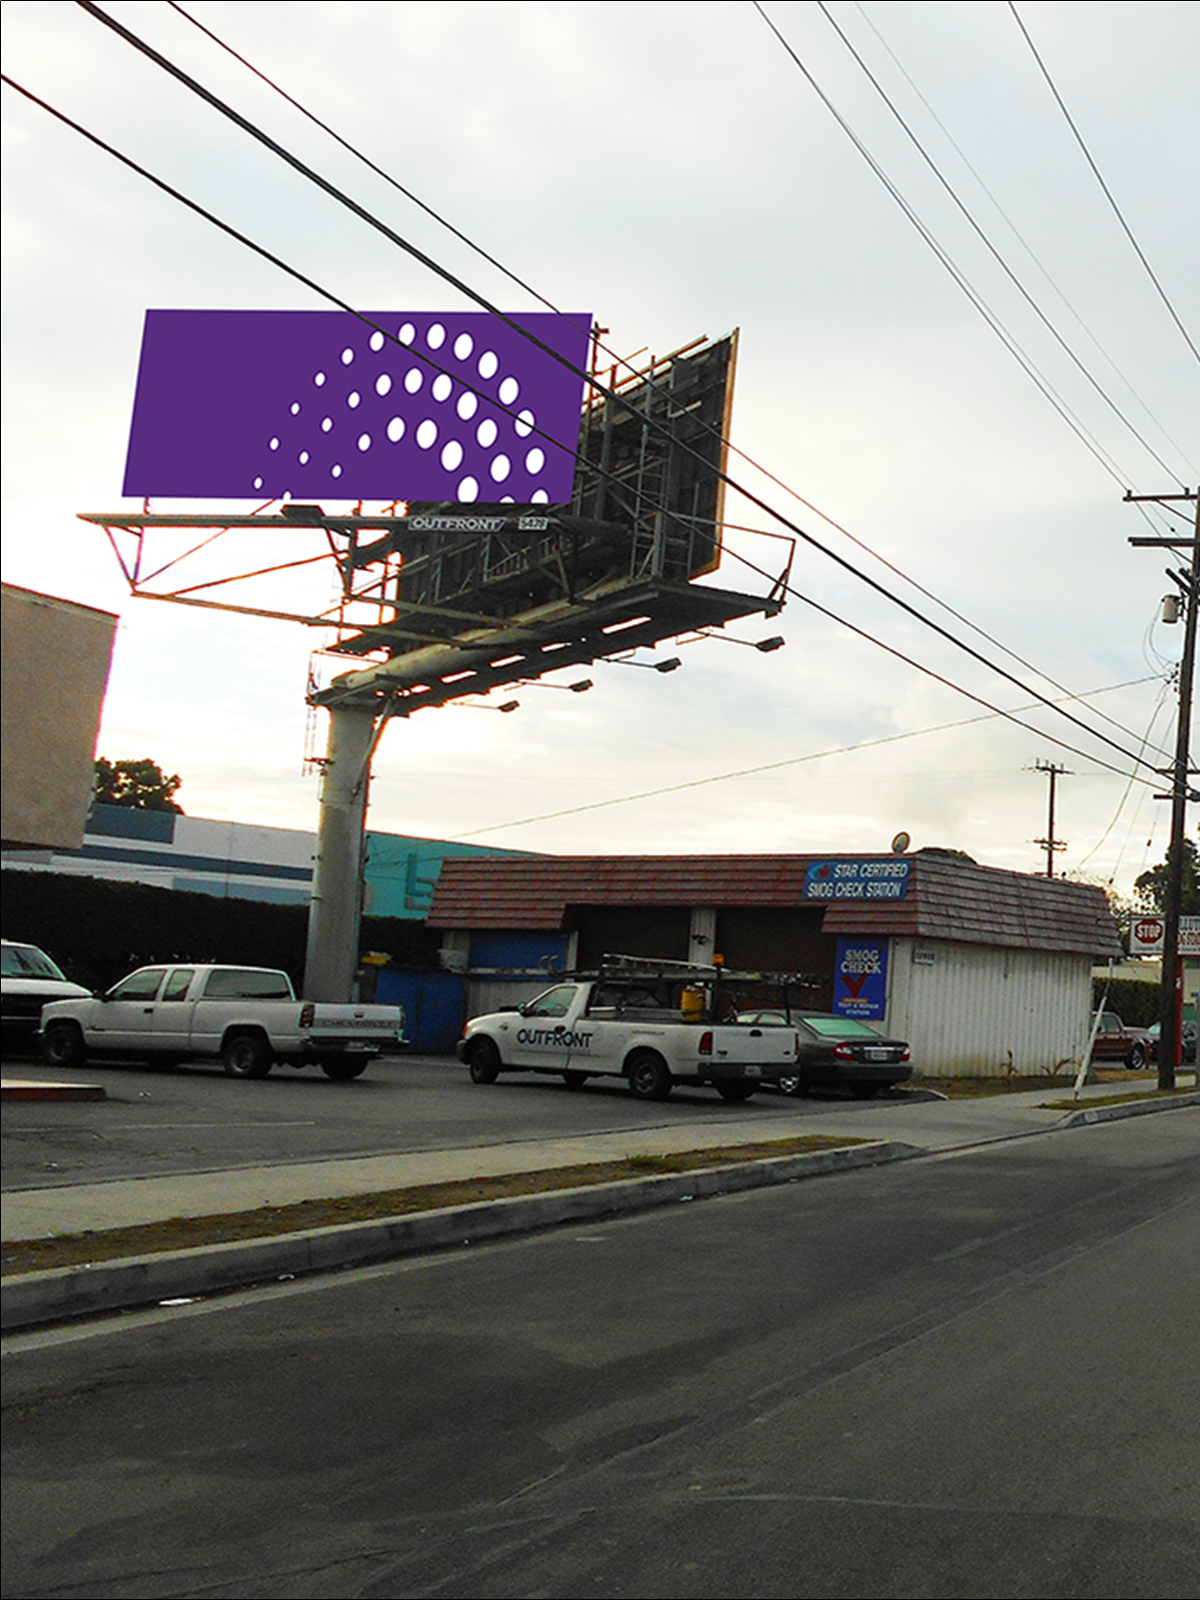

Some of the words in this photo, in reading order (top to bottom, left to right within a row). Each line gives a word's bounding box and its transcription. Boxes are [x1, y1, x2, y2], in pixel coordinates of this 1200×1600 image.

[412, 517, 500, 529] OUTFRONT
[833, 863, 859, 878] STAR
[859, 863, 908, 878] CERTIFIED
[807, 882, 834, 897] SMOG
[834, 882, 865, 897] CHECK
[865, 882, 902, 897] STATION
[1137, 924, 1160, 938] STOP
[845, 949, 880, 961] SMOG
[840, 960, 882, 974] CHECK
[516, 1028, 593, 1048] OUTFRONT
